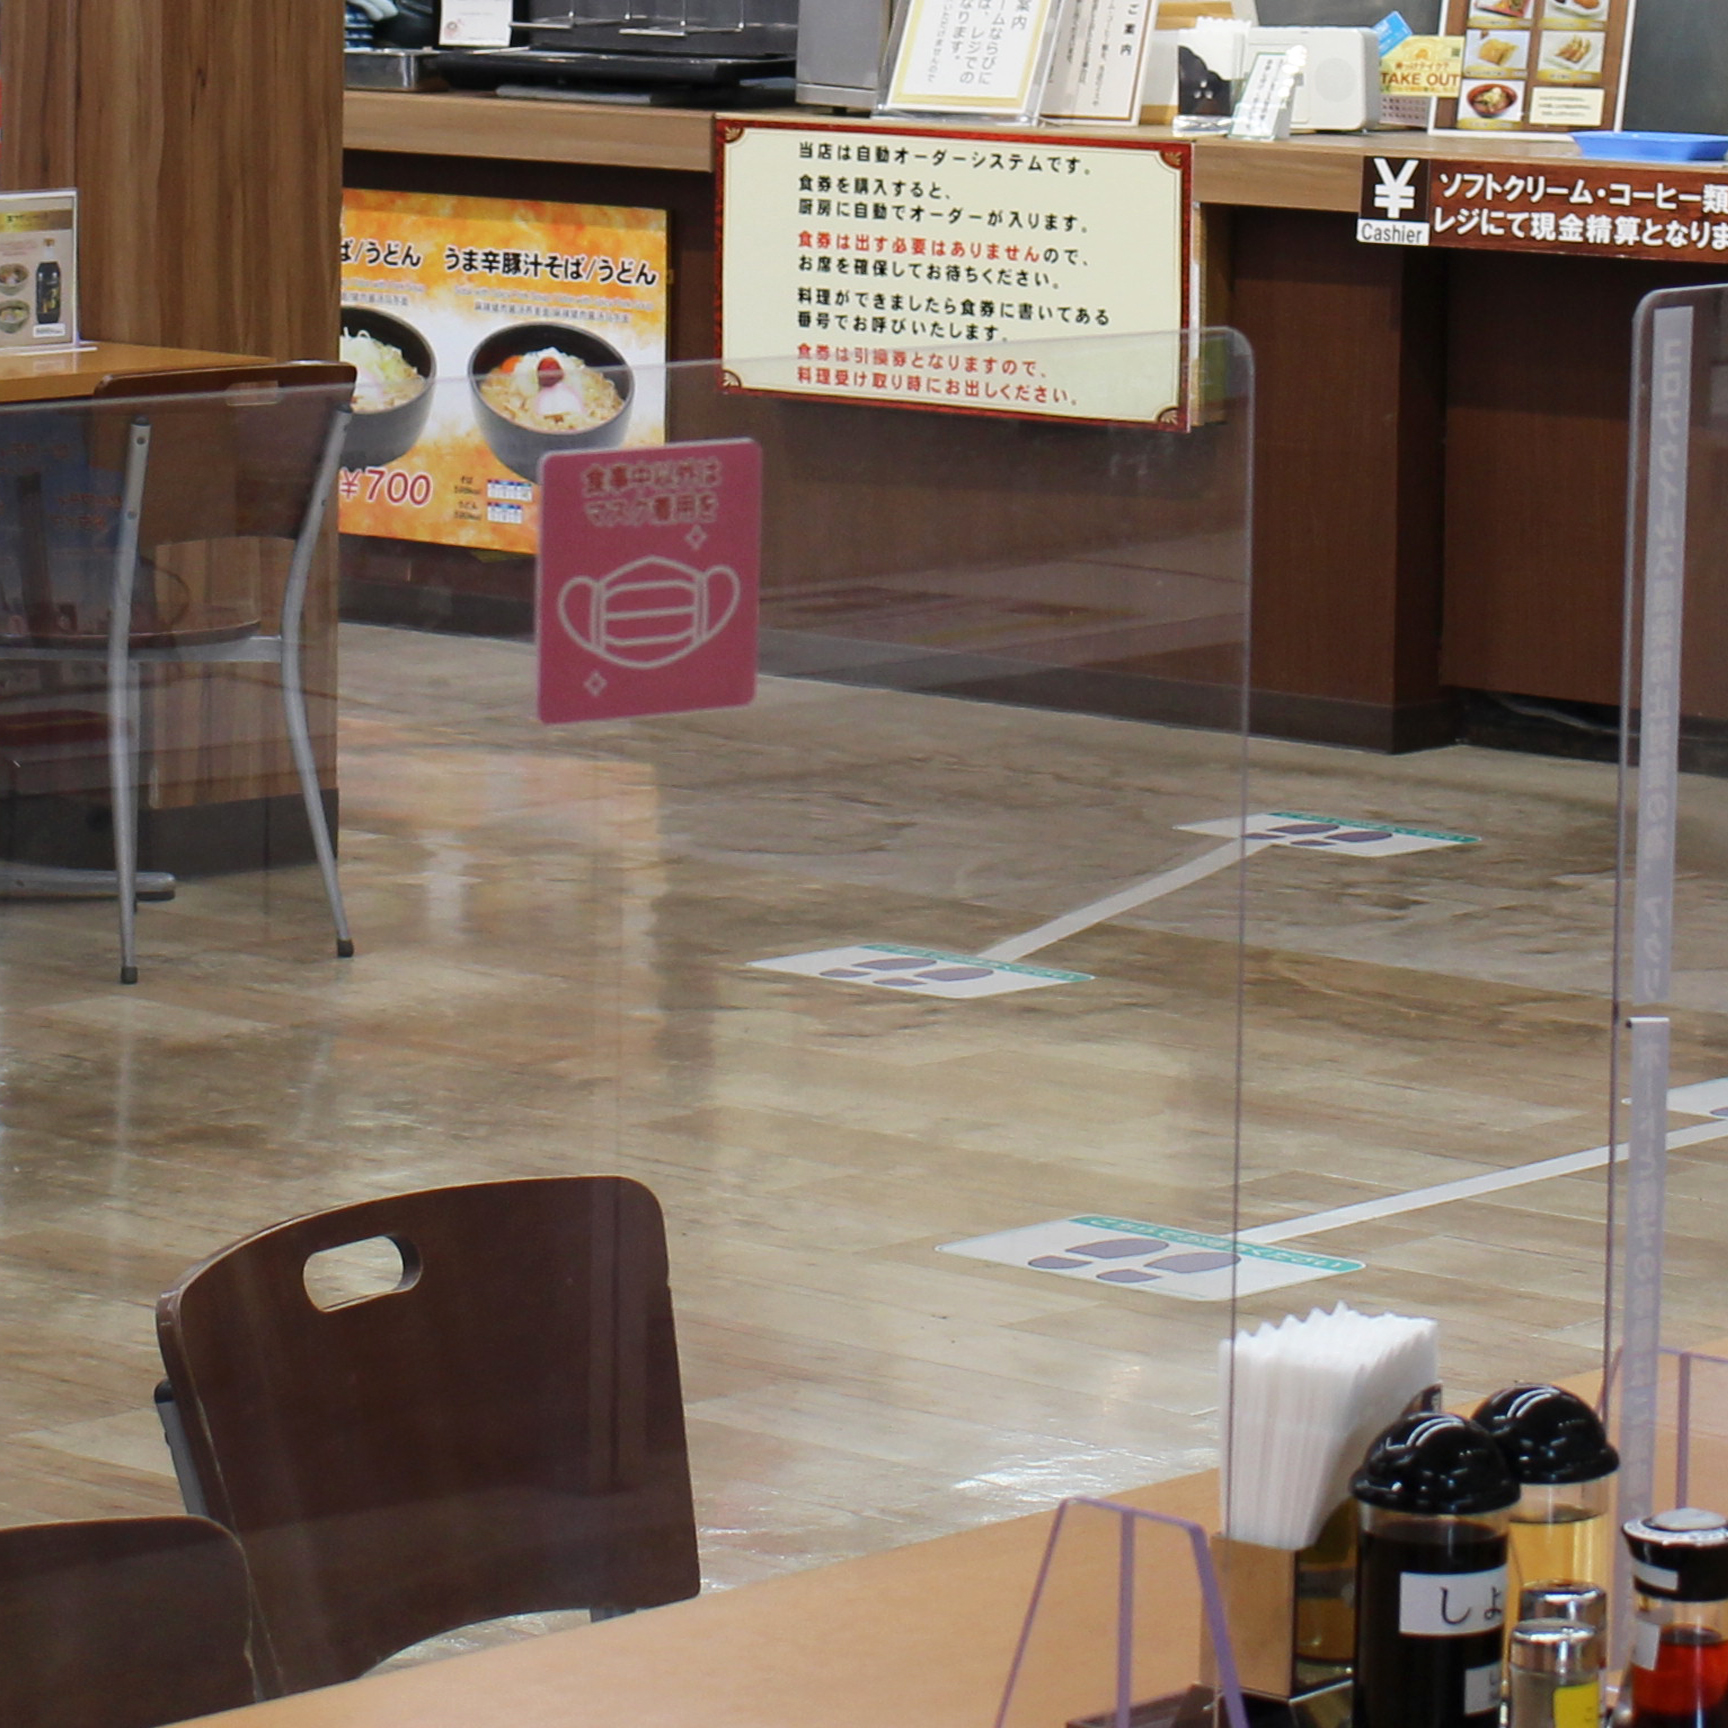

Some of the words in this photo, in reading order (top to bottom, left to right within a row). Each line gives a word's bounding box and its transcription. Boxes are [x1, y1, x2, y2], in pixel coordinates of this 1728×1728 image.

[1381, 71, 1420, 86] TAKE
[1425, 70, 1461, 87] OUT
[797, 139, 1092, 177] 当店は自動オーダーシステムです。
[797, 173, 953, 202] 食券を購入すると、
[796, 197, 1090, 235] 厨房に自動でオーダーが入ります。
[1361, 222, 1424, 246] Cashier
[442, 246, 660, 288] うま辛豚汁そば/うどん
[796, 229, 1091, 267] 食券は出す必要はありませんので、
[796, 254, 1061, 291] お席を確保してお待ちください。
[796, 286, 1112, 328] 料理ができましたら食券に書いてある
[796, 309, 1011, 344] 番号でお呼びいたします。
[796, 342, 1049, 380] 食券は引換券となりますので、
[795, 366, 1080, 407] 料理受け取り時にお出しください。
[339, 465, 433, 507] ¥700
[582, 456, 722, 498] 食事中以外は
